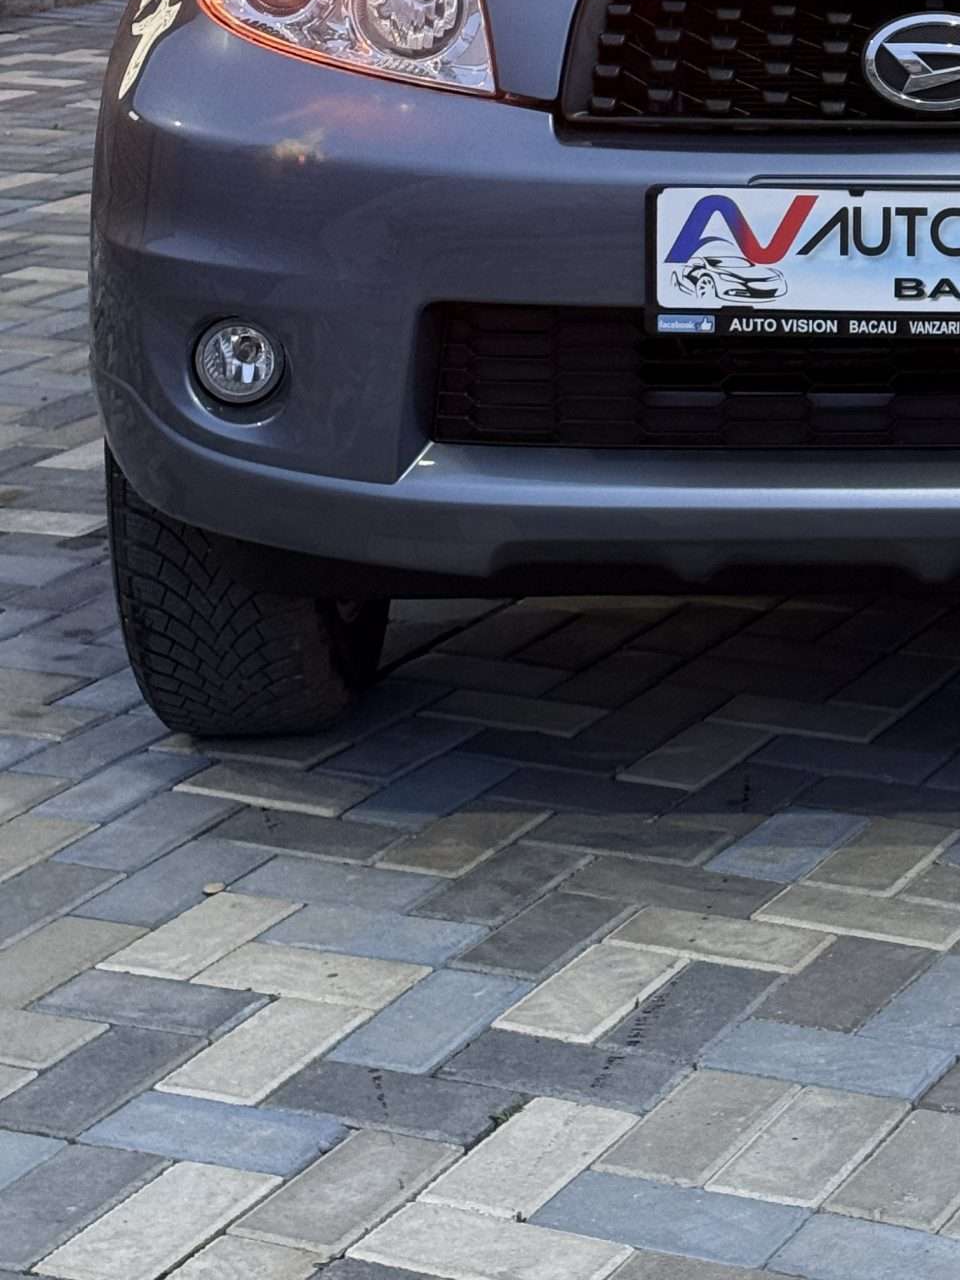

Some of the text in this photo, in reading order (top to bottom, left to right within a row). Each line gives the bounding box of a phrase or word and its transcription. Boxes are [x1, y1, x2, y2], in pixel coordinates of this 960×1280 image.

[729, 318, 777, 333] AUTO
[782, 318, 838, 333] VISION
[849, 320, 897, 334] BACAU
[909, 320, 960, 335] VANZARI
